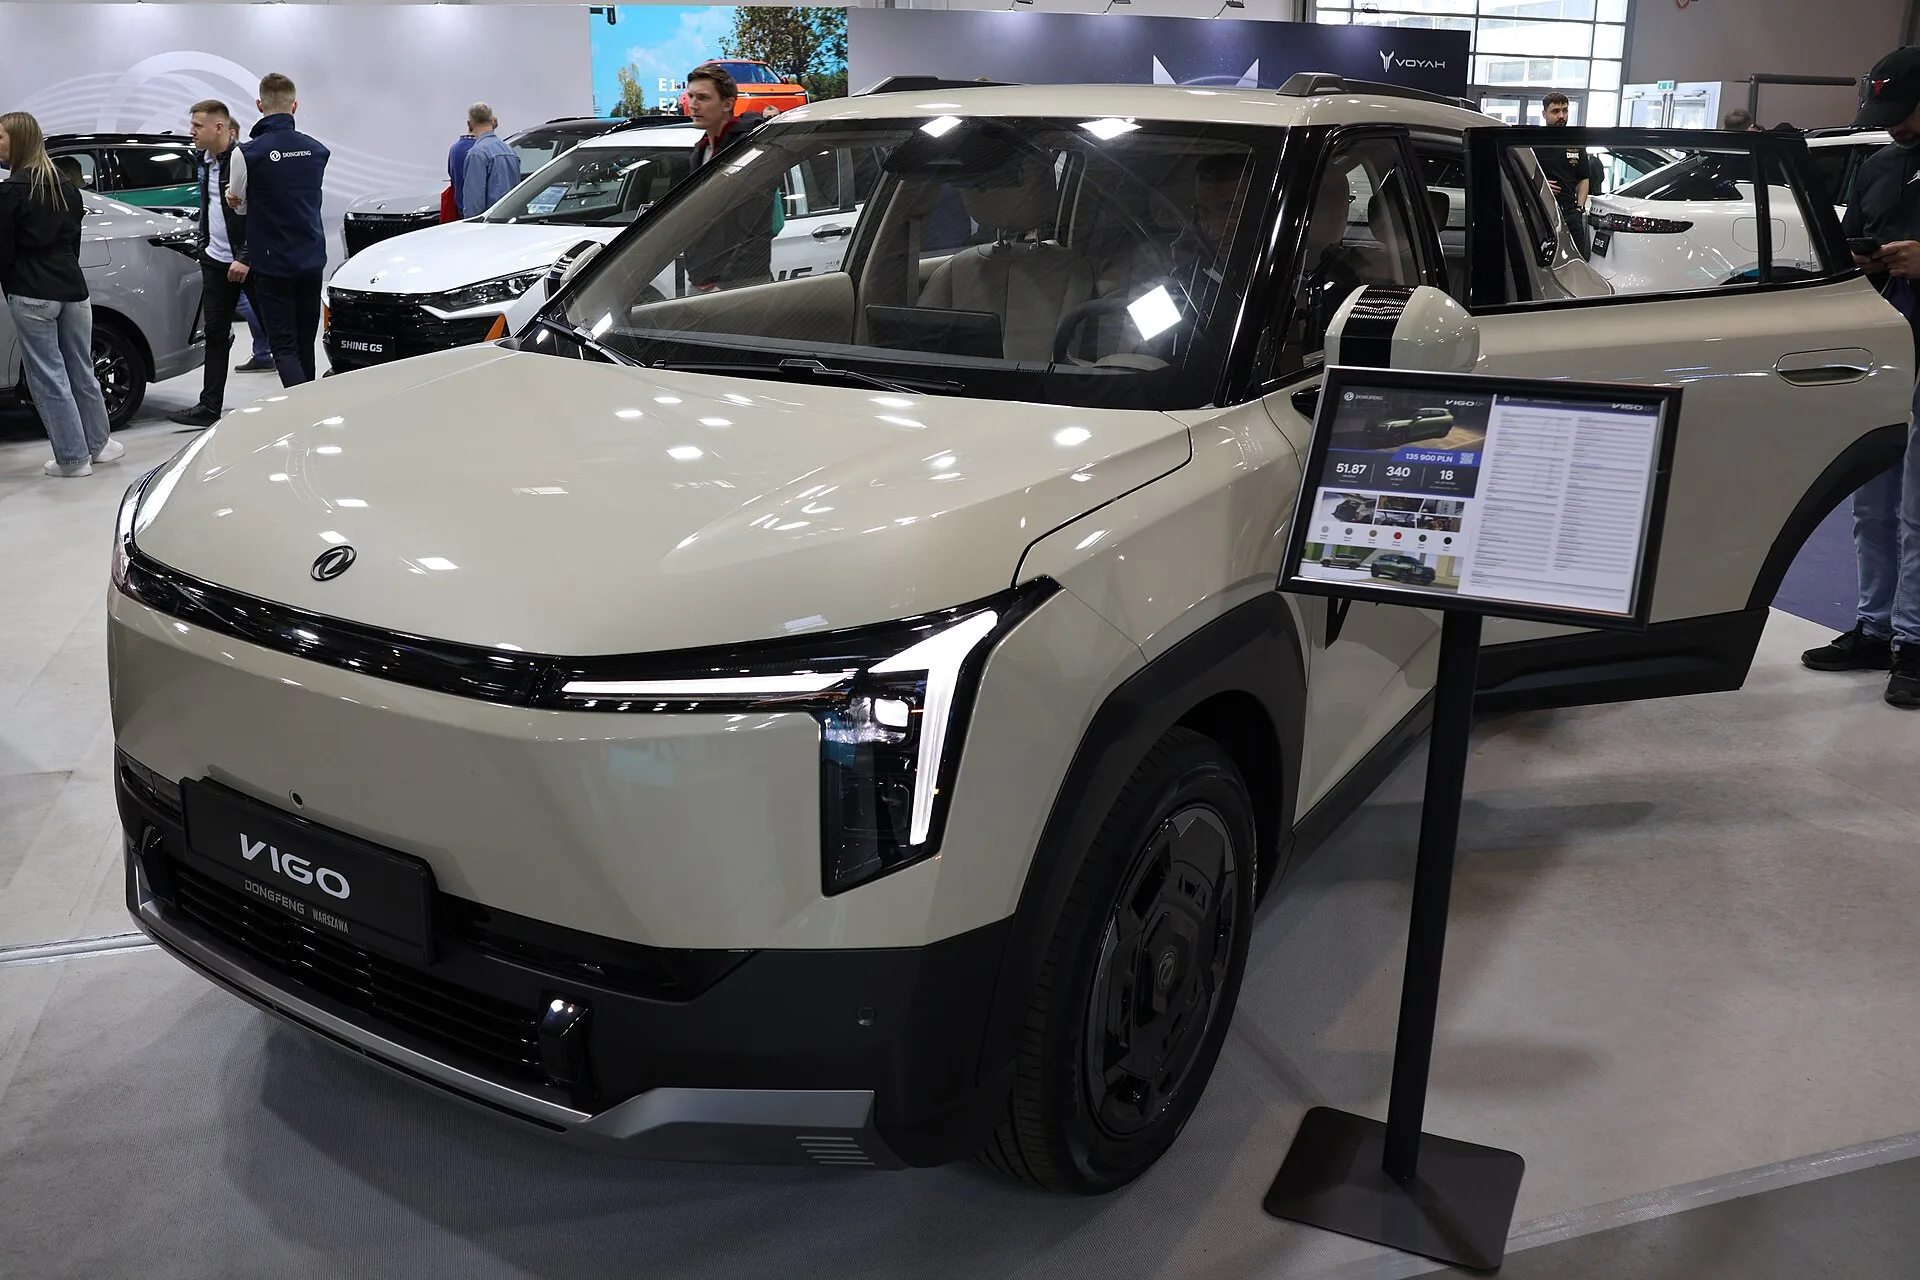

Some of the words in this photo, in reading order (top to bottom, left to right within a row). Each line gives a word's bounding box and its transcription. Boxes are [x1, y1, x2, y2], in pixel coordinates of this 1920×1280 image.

[1395, 58, 1446, 69] VOYAH
[658, 97, 679, 112] E2
[282, 150, 312, 158] DONGFENG
[341, 340, 368, 351] SHINE
[369, 343, 383, 353] GS
[1611, 403, 1644, 411] VIGO
[1420, 454, 1436, 462] 900
[1437, 455, 1454, 463] PLN
[1336, 463, 1367, 475] 51.87
[1386, 466, 1411, 477] 340
[1440, 470, 1454, 480] 18
[239, 832, 351, 900] VIGO
[244, 879, 305, 915] DONGFENG
[312, 908, 349, 934] WARSZAWA
